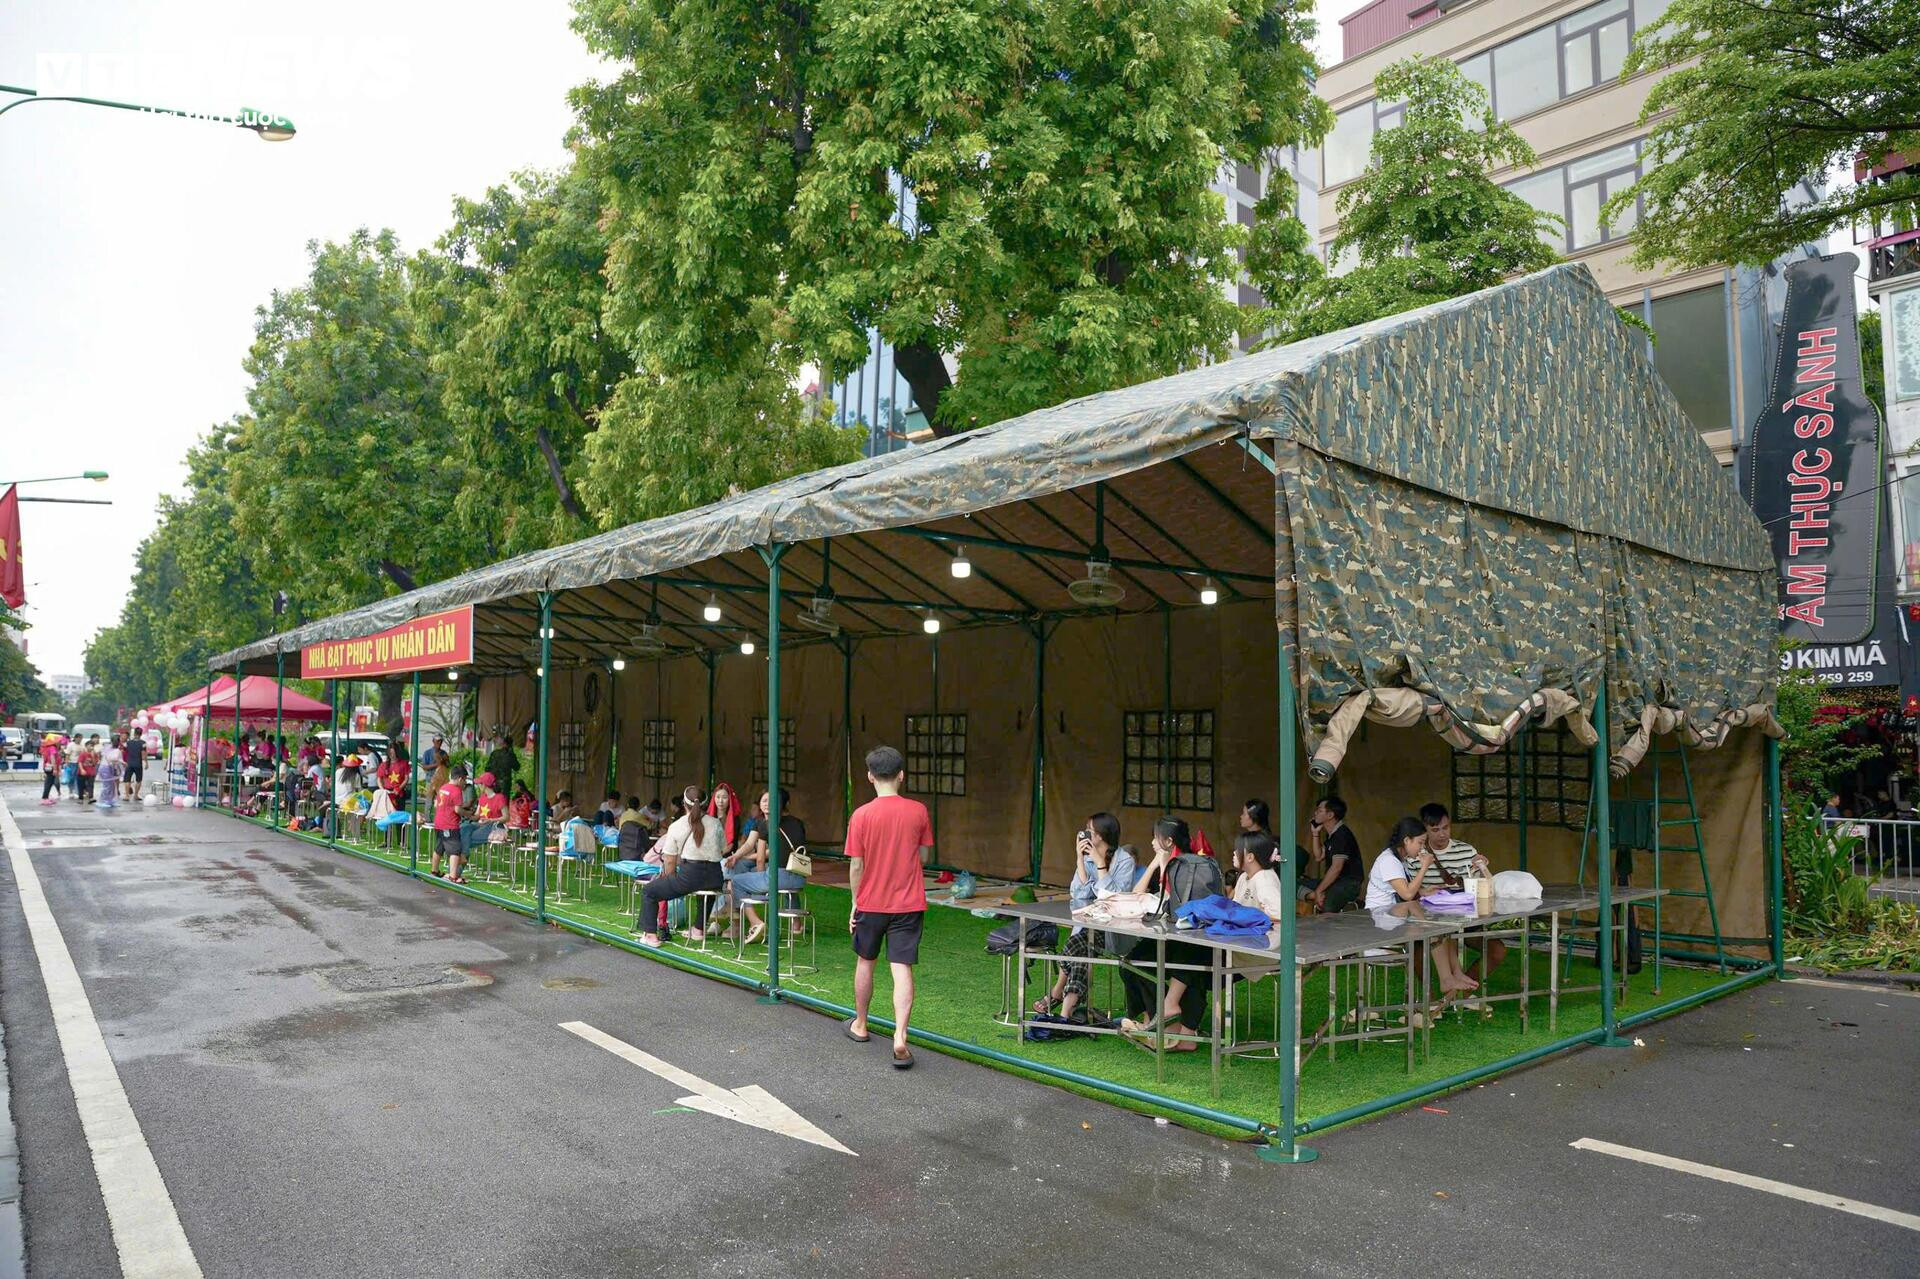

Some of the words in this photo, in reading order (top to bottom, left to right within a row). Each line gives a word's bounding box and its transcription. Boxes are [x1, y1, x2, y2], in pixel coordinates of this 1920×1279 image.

[1782, 327, 1838, 439] SÀNH
[1787, 447, 1843, 556] THỰC
[308, 644, 326, 670] NHÀ
[327, 644, 344, 671] BẠT
[346, 639, 373, 670] PHỤC
[375, 636, 390, 667] VỤ
[392, 626, 424, 661] NHÂN
[427, 619, 456, 655] DÂN
[1797, 647, 1840, 669] KIM
[1844, 640, 1887, 666] MÃ
[1818, 672, 1844, 684] 259
[1847, 671, 1874, 683] 259
